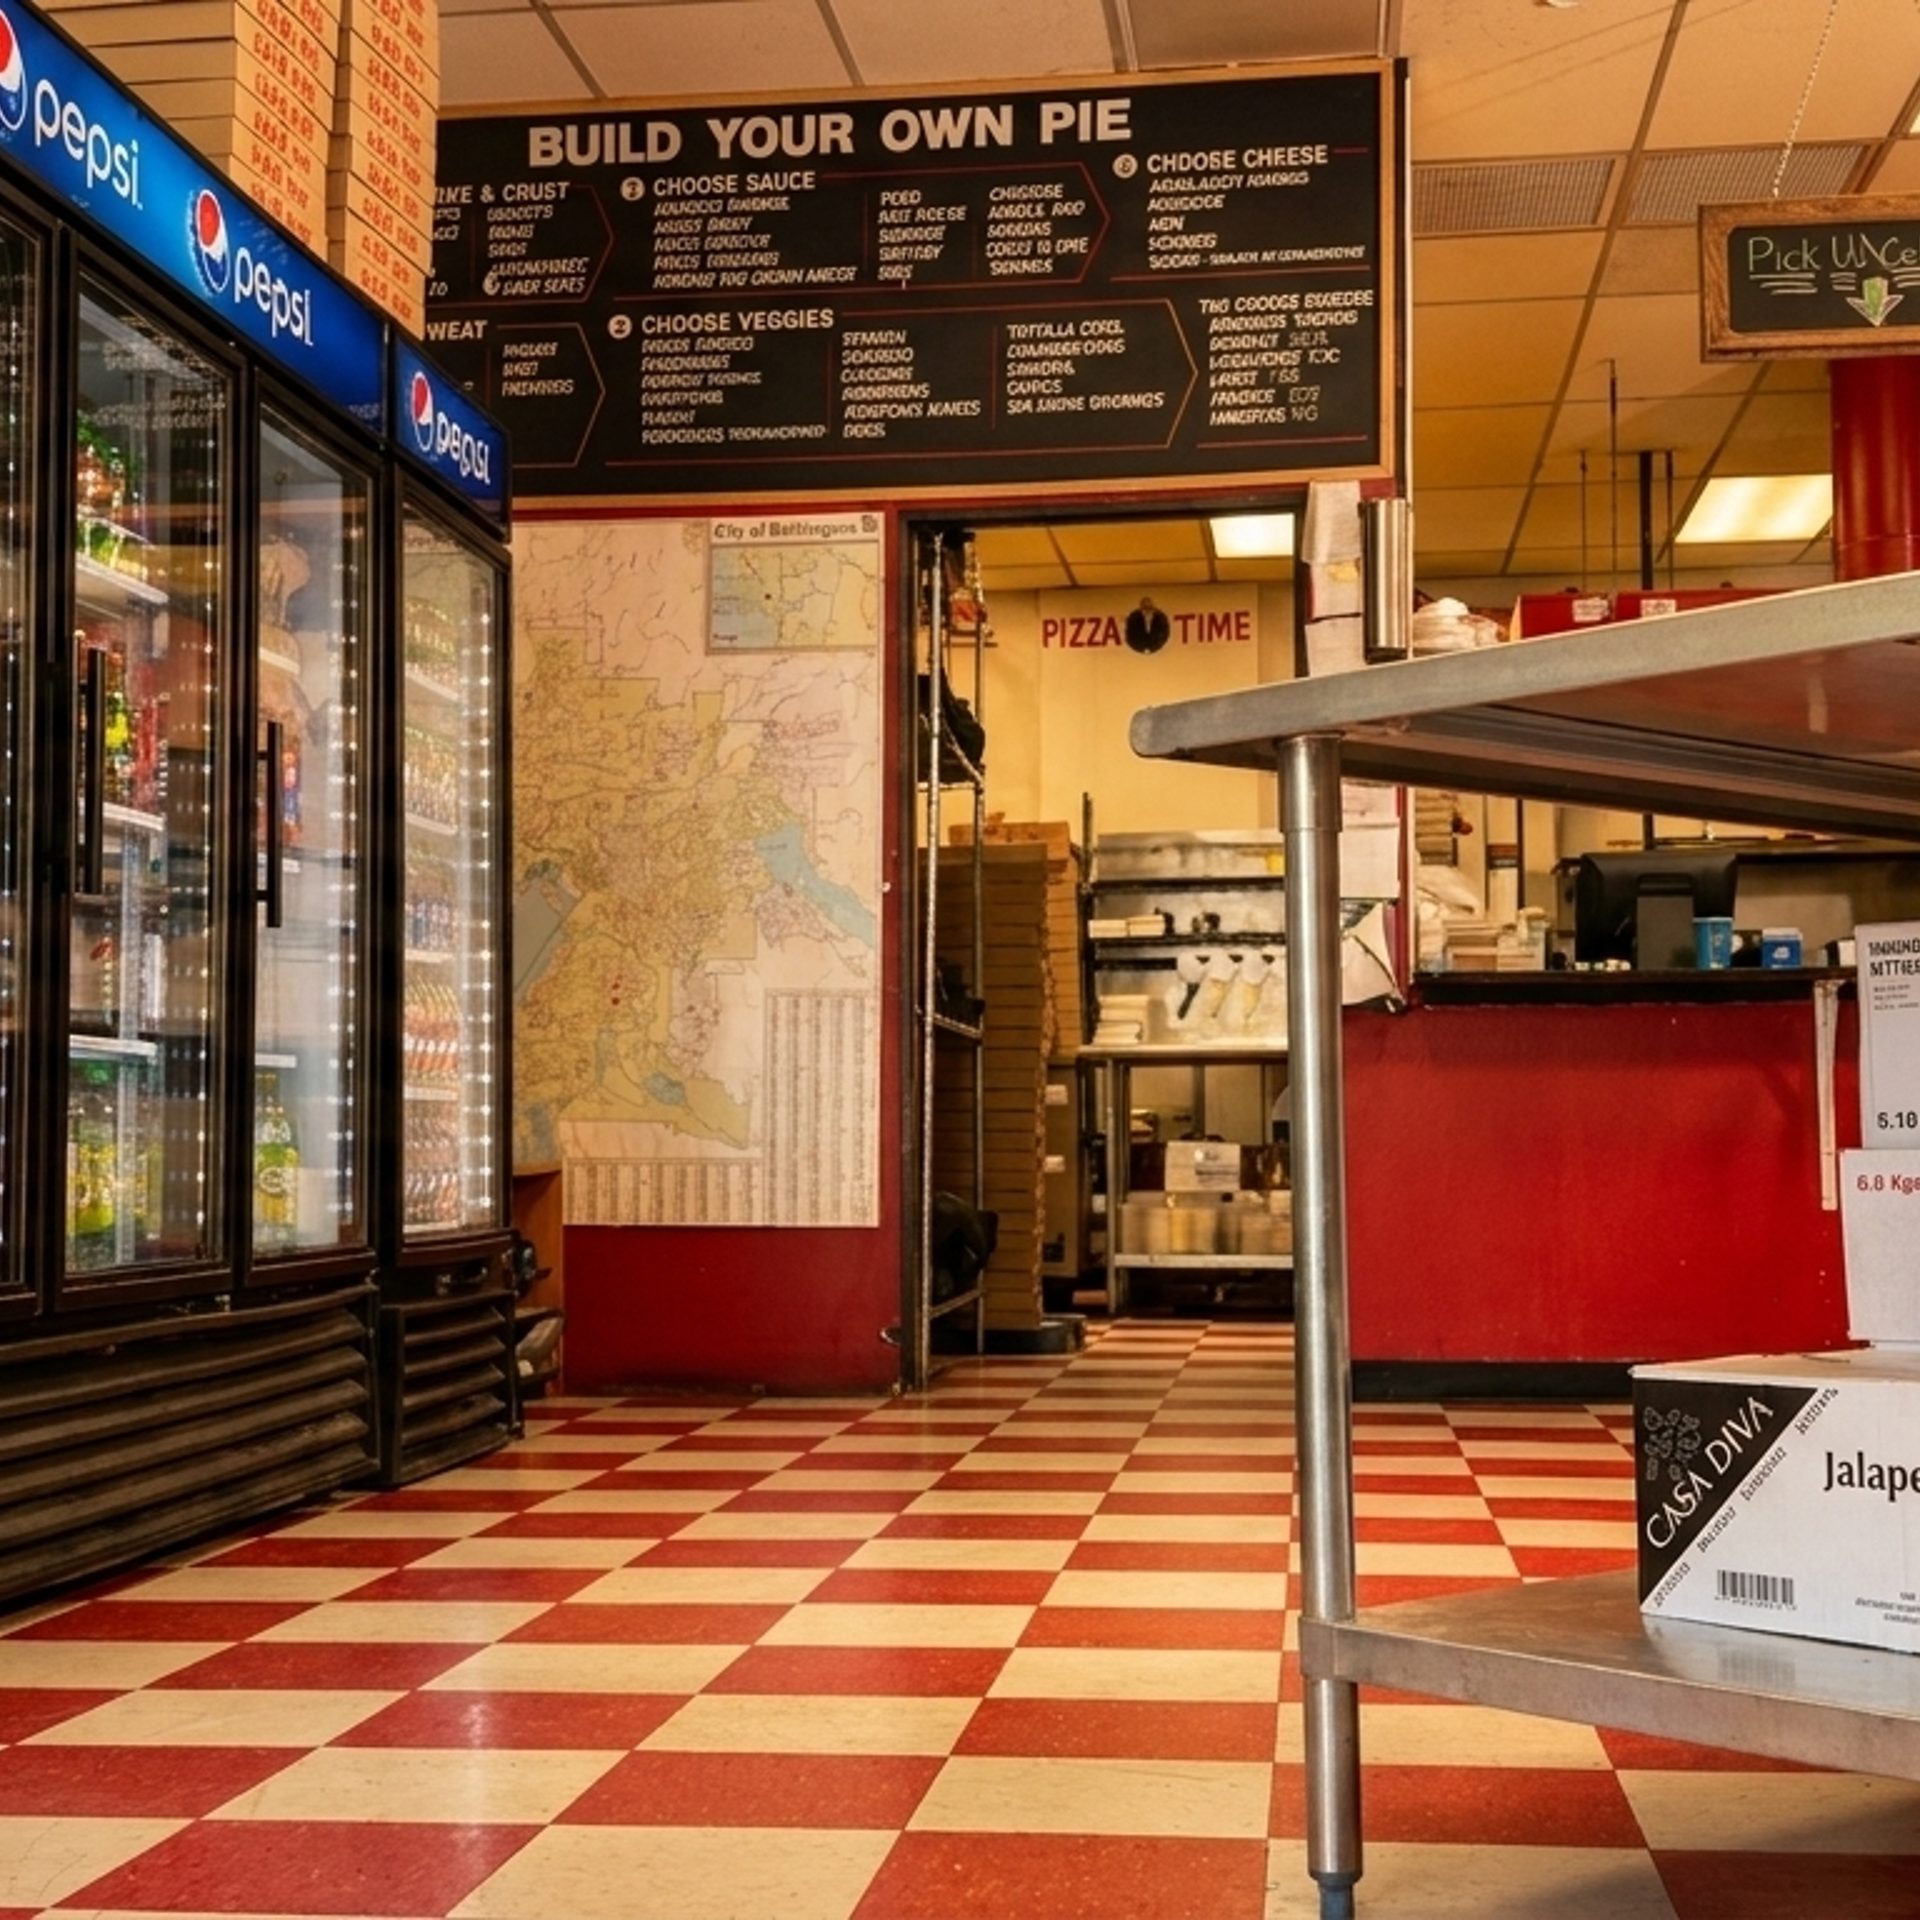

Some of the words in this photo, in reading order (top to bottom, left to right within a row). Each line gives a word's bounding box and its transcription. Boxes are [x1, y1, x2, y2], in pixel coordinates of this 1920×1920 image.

[34, 78, 140, 206] pepsi
[528, 120, 682, 168] BUILD
[706, 112, 855, 160] YOUR
[879, 104, 1014, 153] OWN
[1039, 97, 1132, 145] PIE
[479, 183, 495, 204] &
[502, 181, 571, 203] CRUST
[652, 173, 739, 196] CHOOSE
[746, 170, 816, 193] SAUCE
[1748, 235, 1822, 273] Pick
[234, 246, 314, 347] pepsi
[641, 312, 732, 335] CHOOSE
[737, 308, 835, 332] VEGGIES
[749, 521, 766, 538] of
[1041, 616, 1122, 649] PIZZA
[1173, 611, 1252, 645] TIME
[1645, 1468, 1714, 1549] CASA
[1703, 1396, 1775, 1477] DIVA
